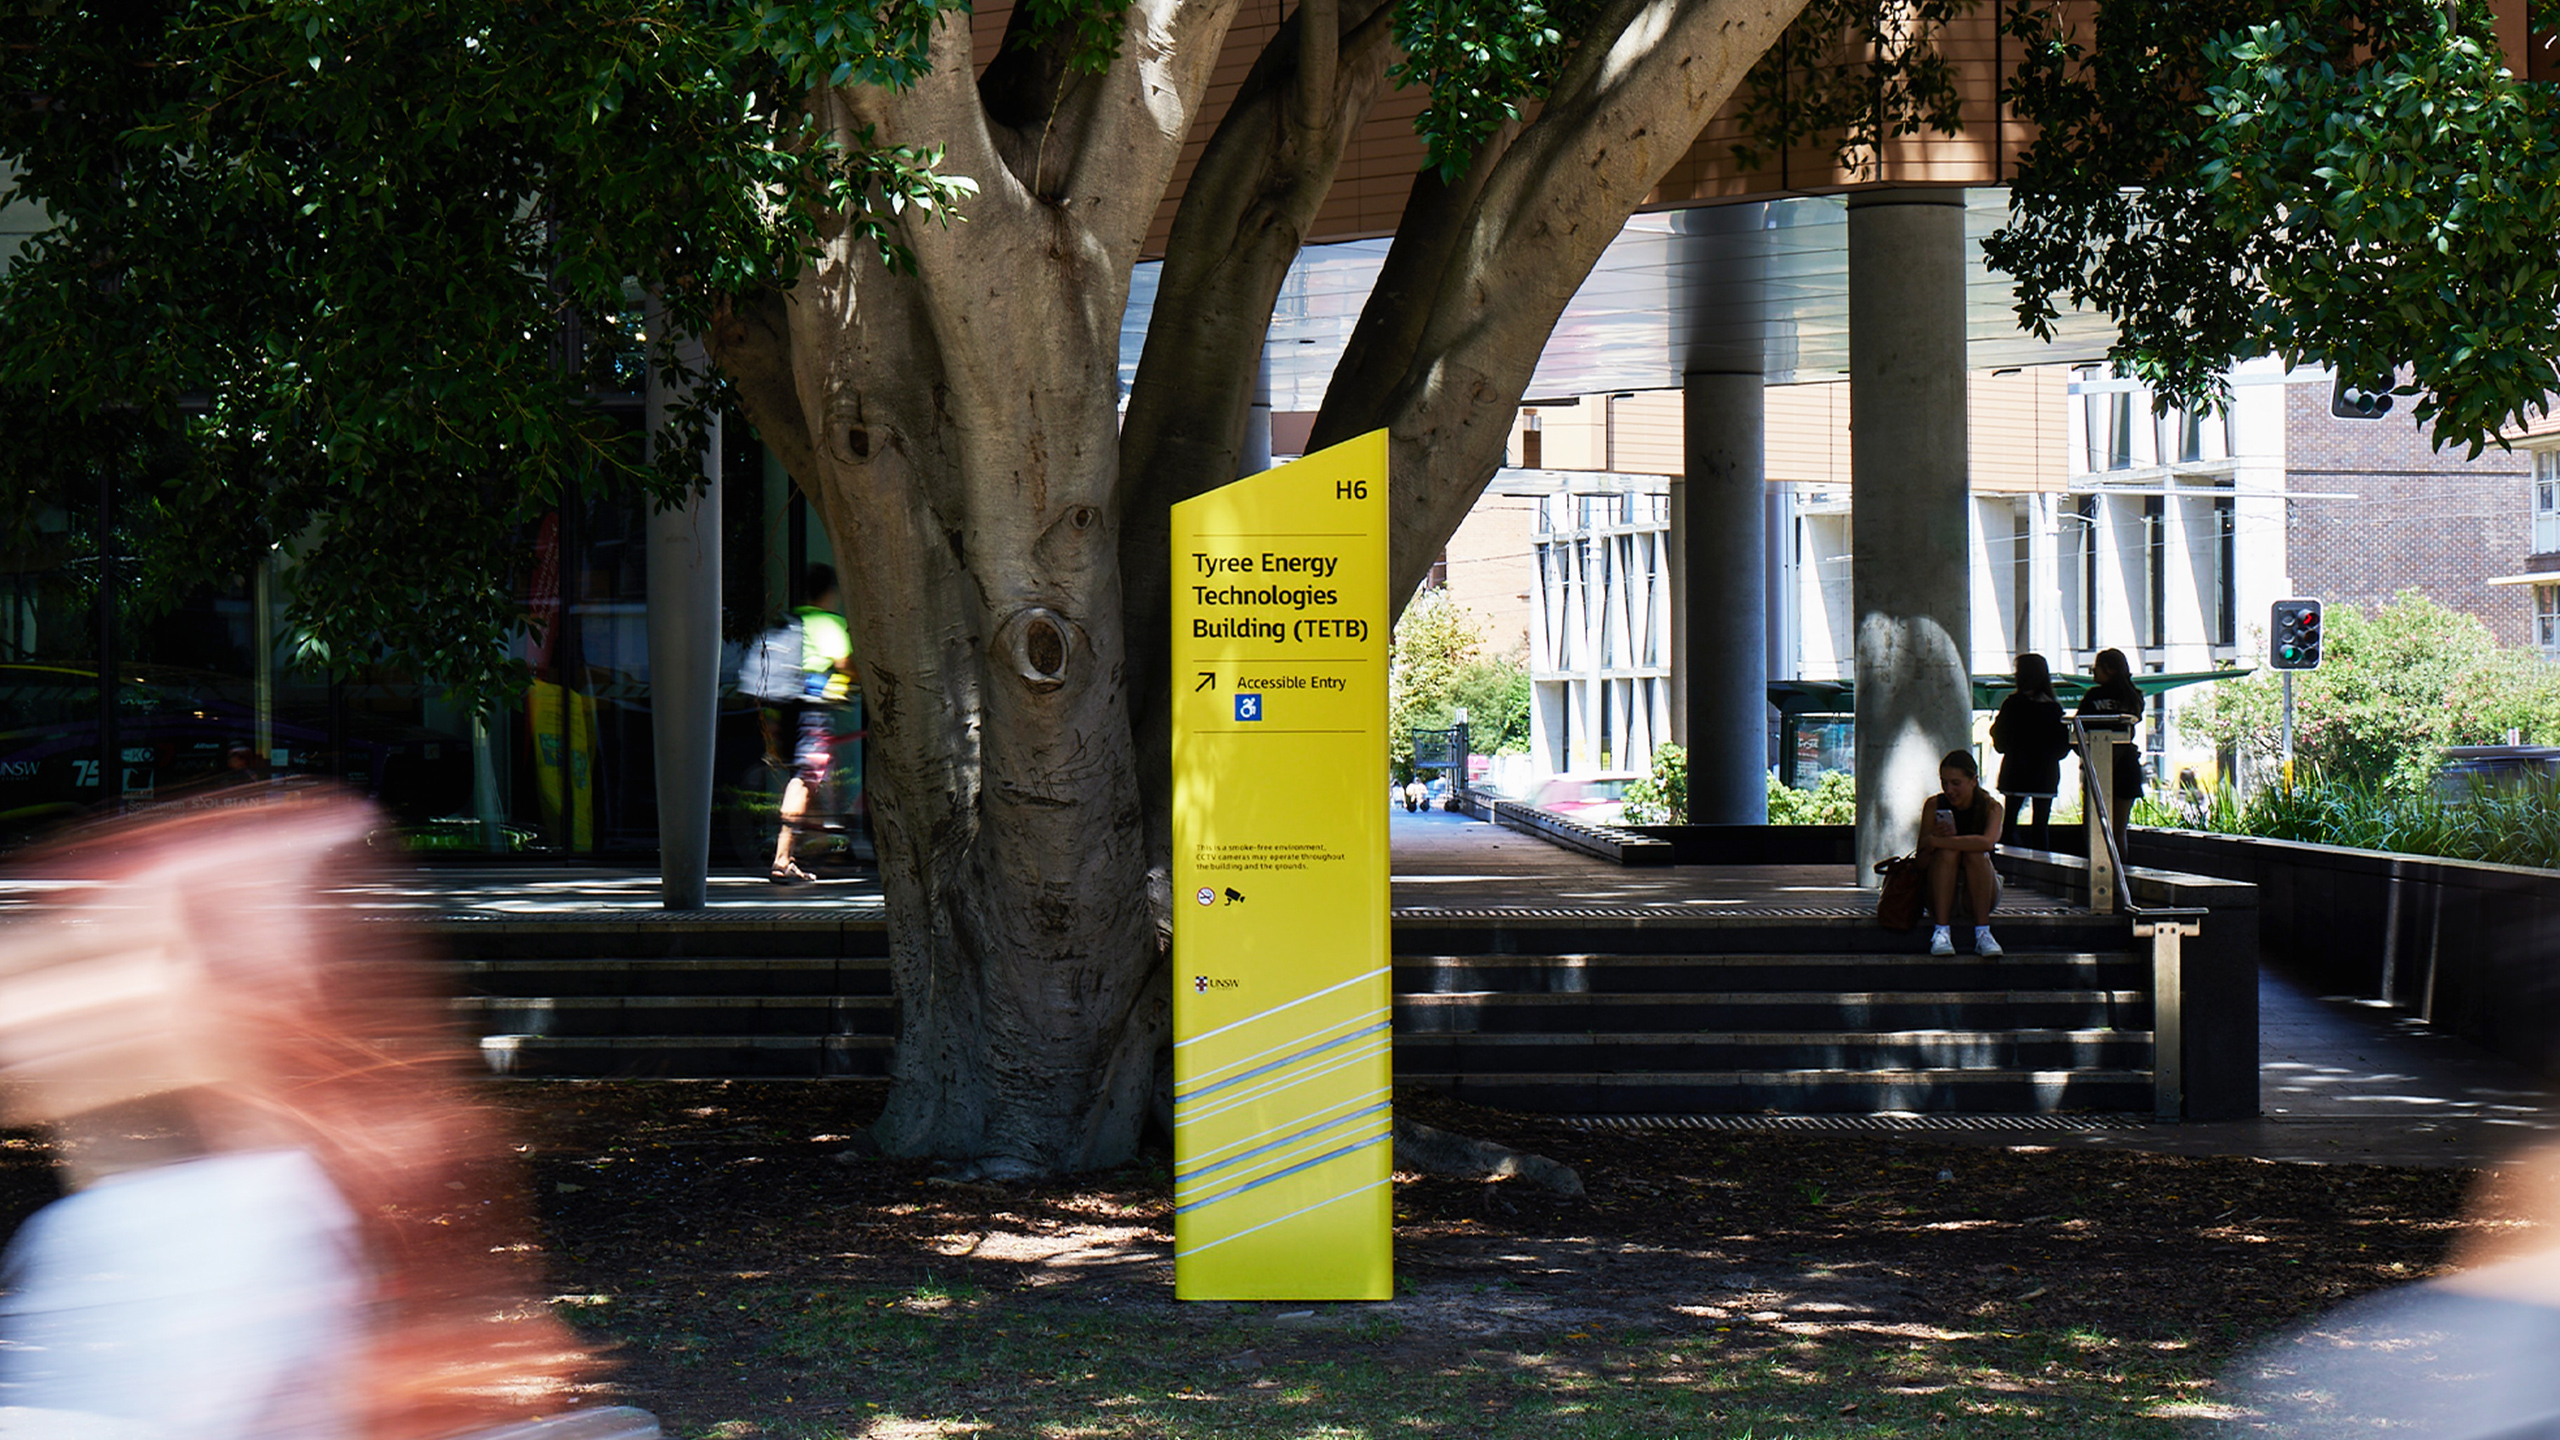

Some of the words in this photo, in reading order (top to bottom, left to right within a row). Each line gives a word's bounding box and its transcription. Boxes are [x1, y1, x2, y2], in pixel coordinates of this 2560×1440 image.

[1336, 480, 1368, 500] H6
[1192, 553, 1254, 577] Tyree
[1262, 553, 1338, 577] Energy
[1192, 584, 1337, 610] Technologies
[1193, 617, 1285, 642] Building
[1294, 619, 1368, 642] (TETB)
[1237, 676, 1306, 689] Accessible
[1311, 676, 1346, 691] Entry
[1196, 853, 1217, 861] CCTV
[1252, 854, 1268, 863] may
[1270, 853, 1300, 863] operate
[1301, 853, 1345, 863] throughout
[1210, 863, 1243, 872] building
[1210, 979, 1239, 988] UNSW
